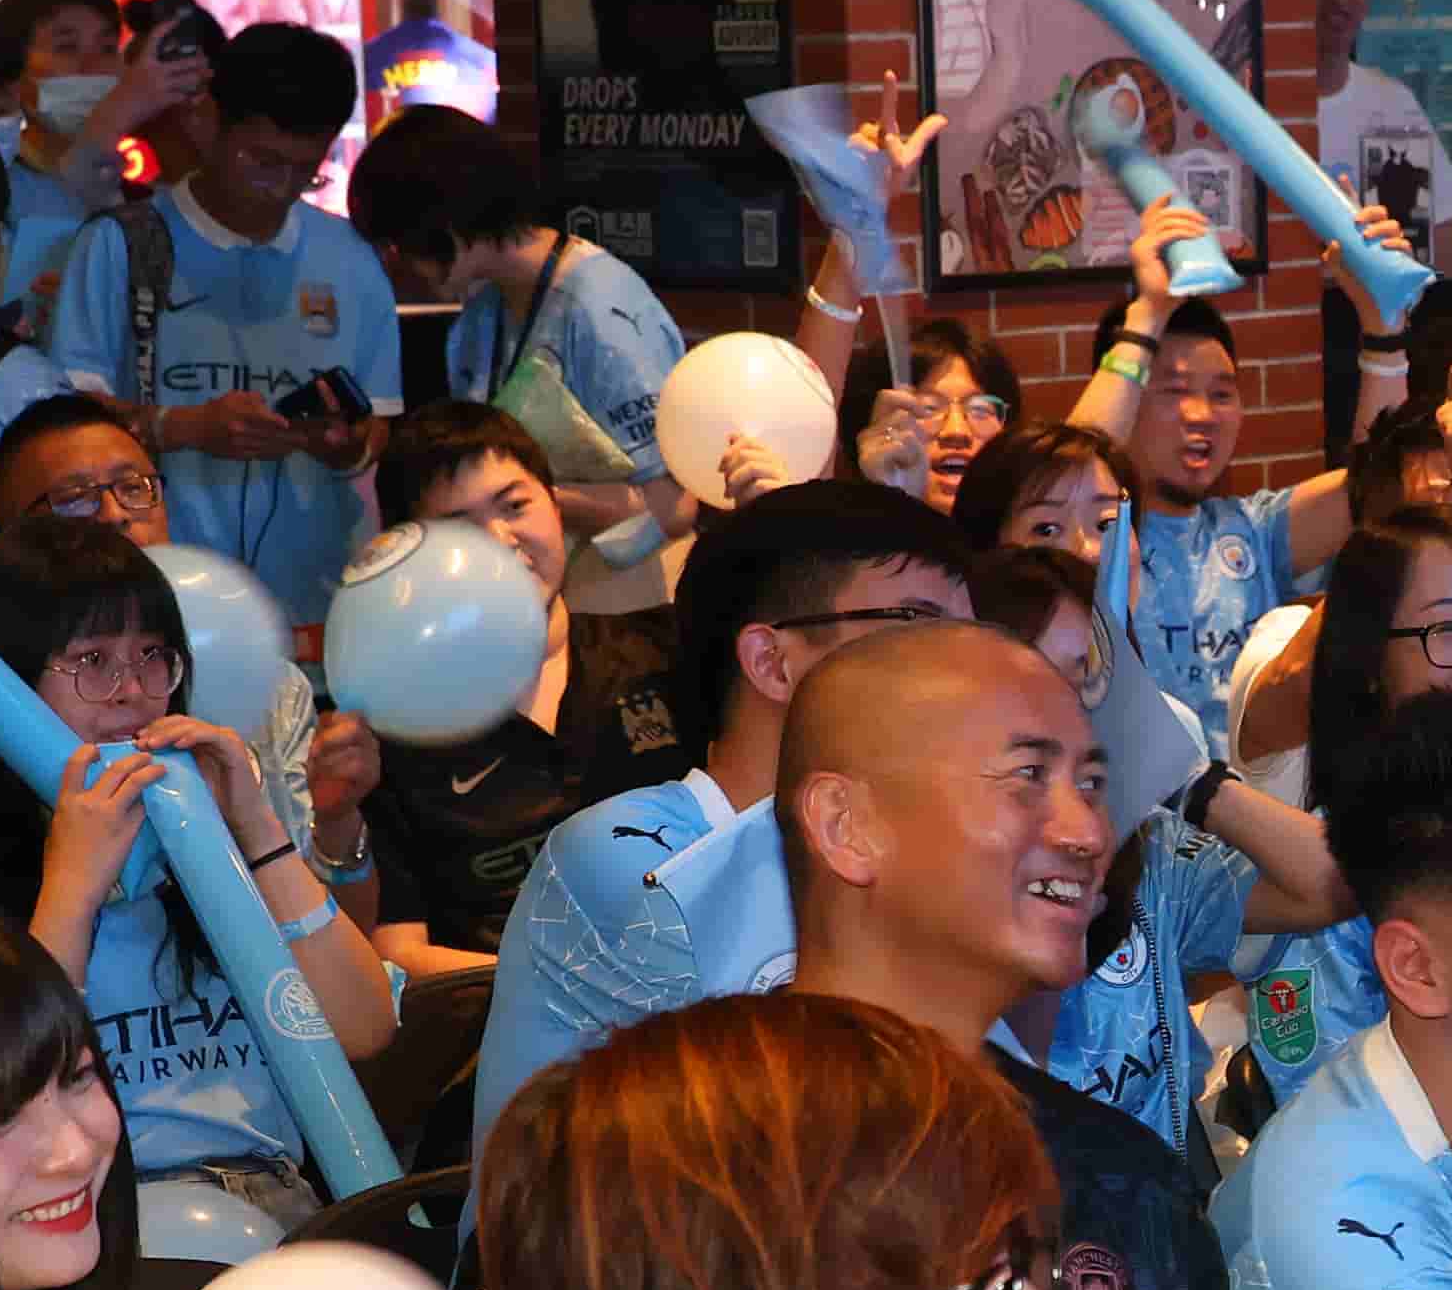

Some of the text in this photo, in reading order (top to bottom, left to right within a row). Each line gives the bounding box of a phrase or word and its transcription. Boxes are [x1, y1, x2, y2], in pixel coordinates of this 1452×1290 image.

[563, 76, 638, 109] DROPS
[563, 110, 746, 148] EVERY MONDAY
[164, 363, 338, 393] ETIHA
